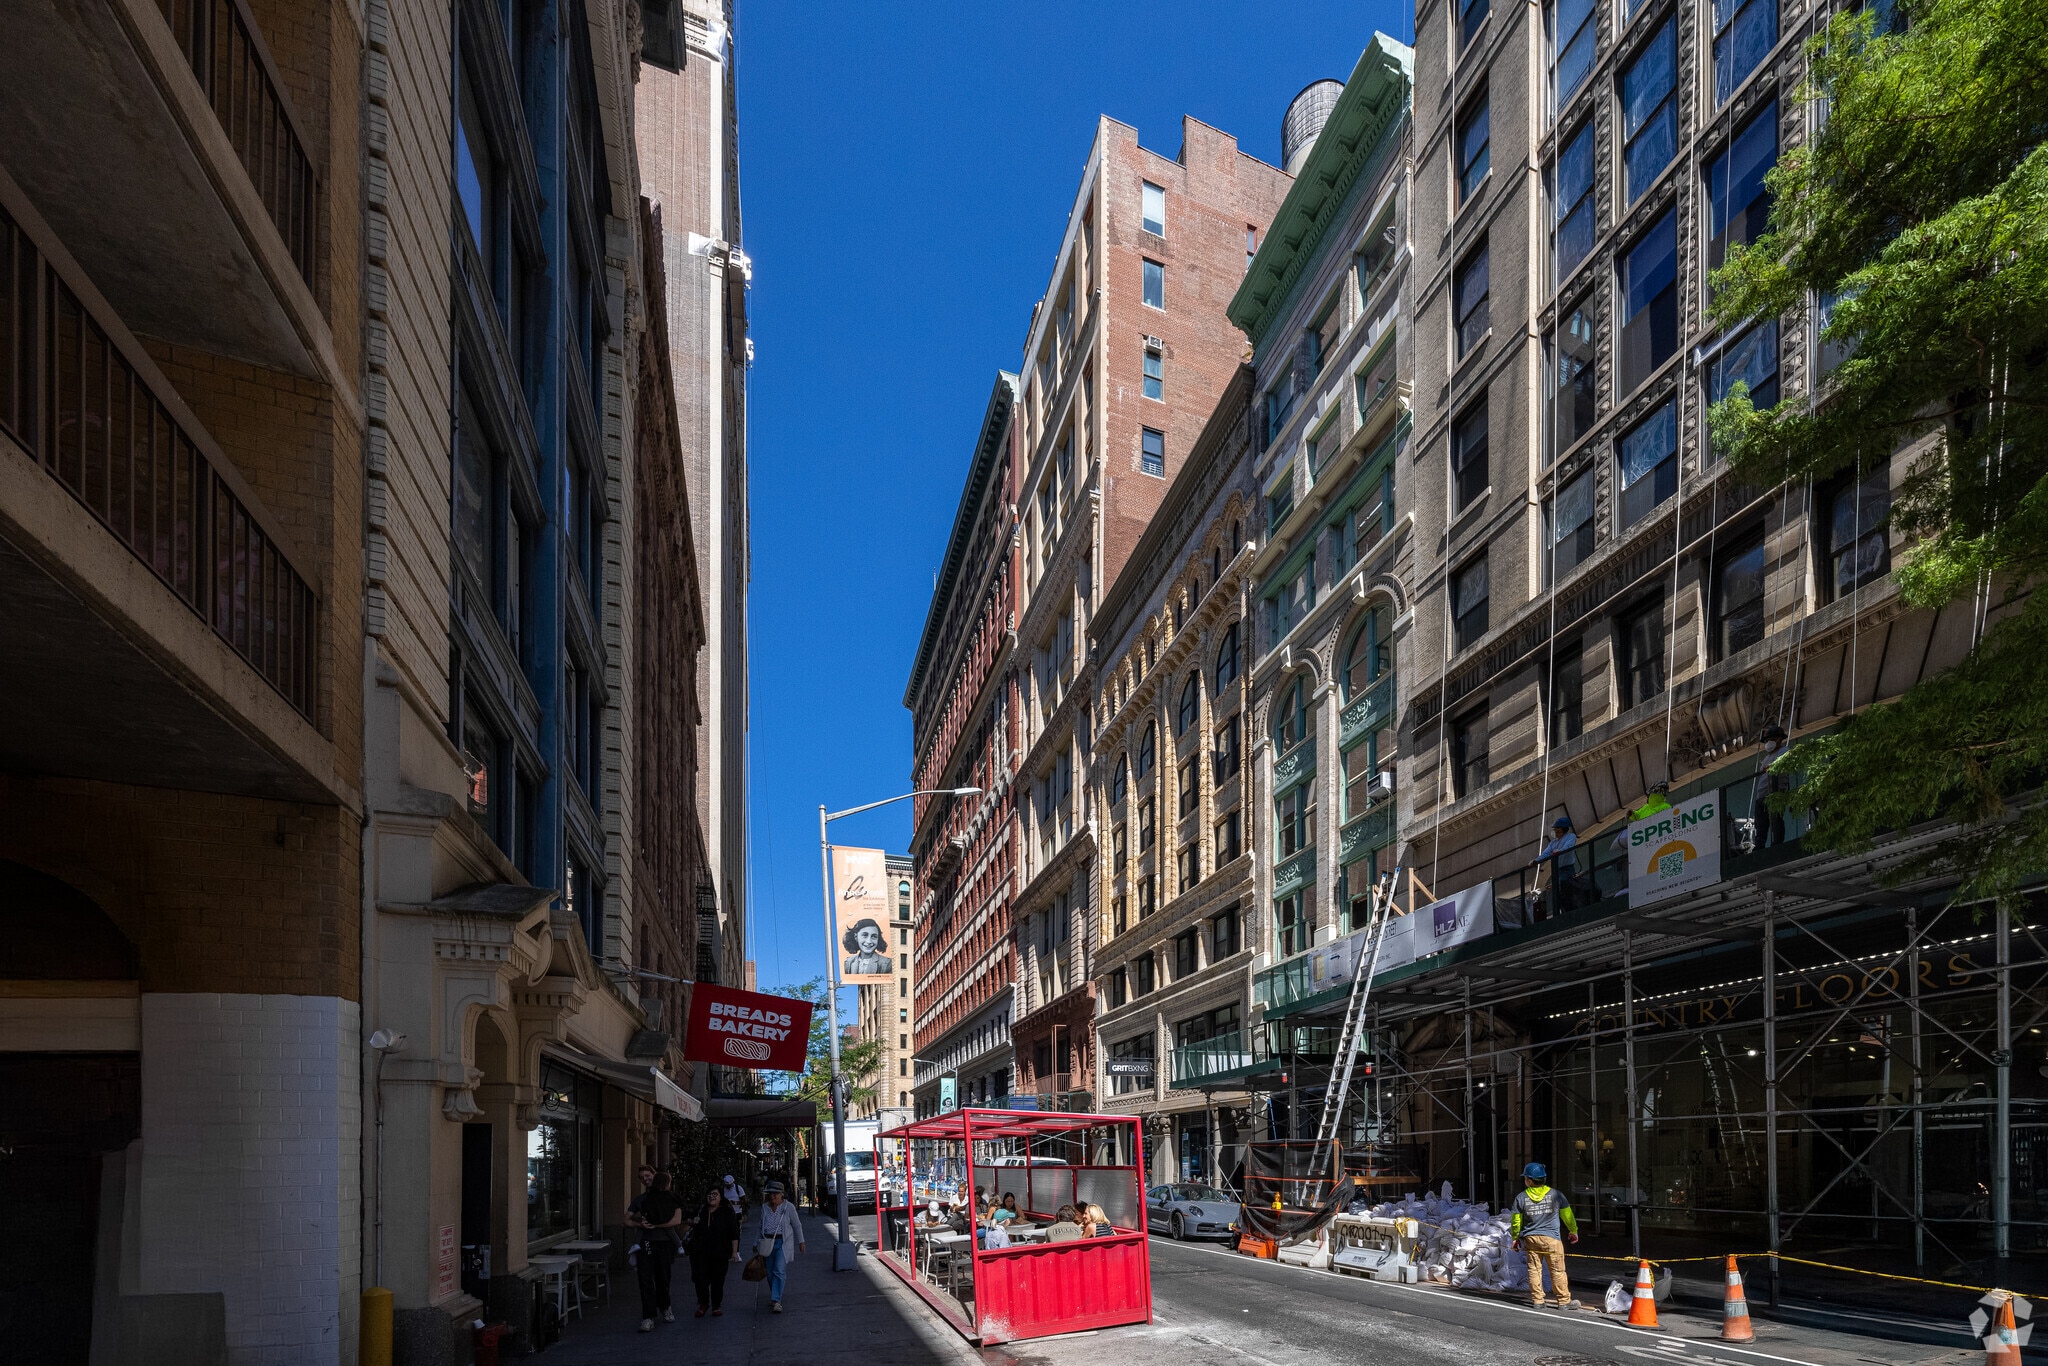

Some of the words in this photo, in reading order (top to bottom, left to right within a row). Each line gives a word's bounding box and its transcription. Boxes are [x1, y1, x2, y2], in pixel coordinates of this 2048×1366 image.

[1644, 825, 1699, 849] SCAFFOLDING
[1435, 919, 1455, 937] HLZ
[709, 1002, 792, 1027] BREADS
[1574, 995, 1739, 1041] COUNTRY
[708, 1017, 791, 1042] BAKERY
[1111, 1064, 1149, 1073] GRITBXNG
